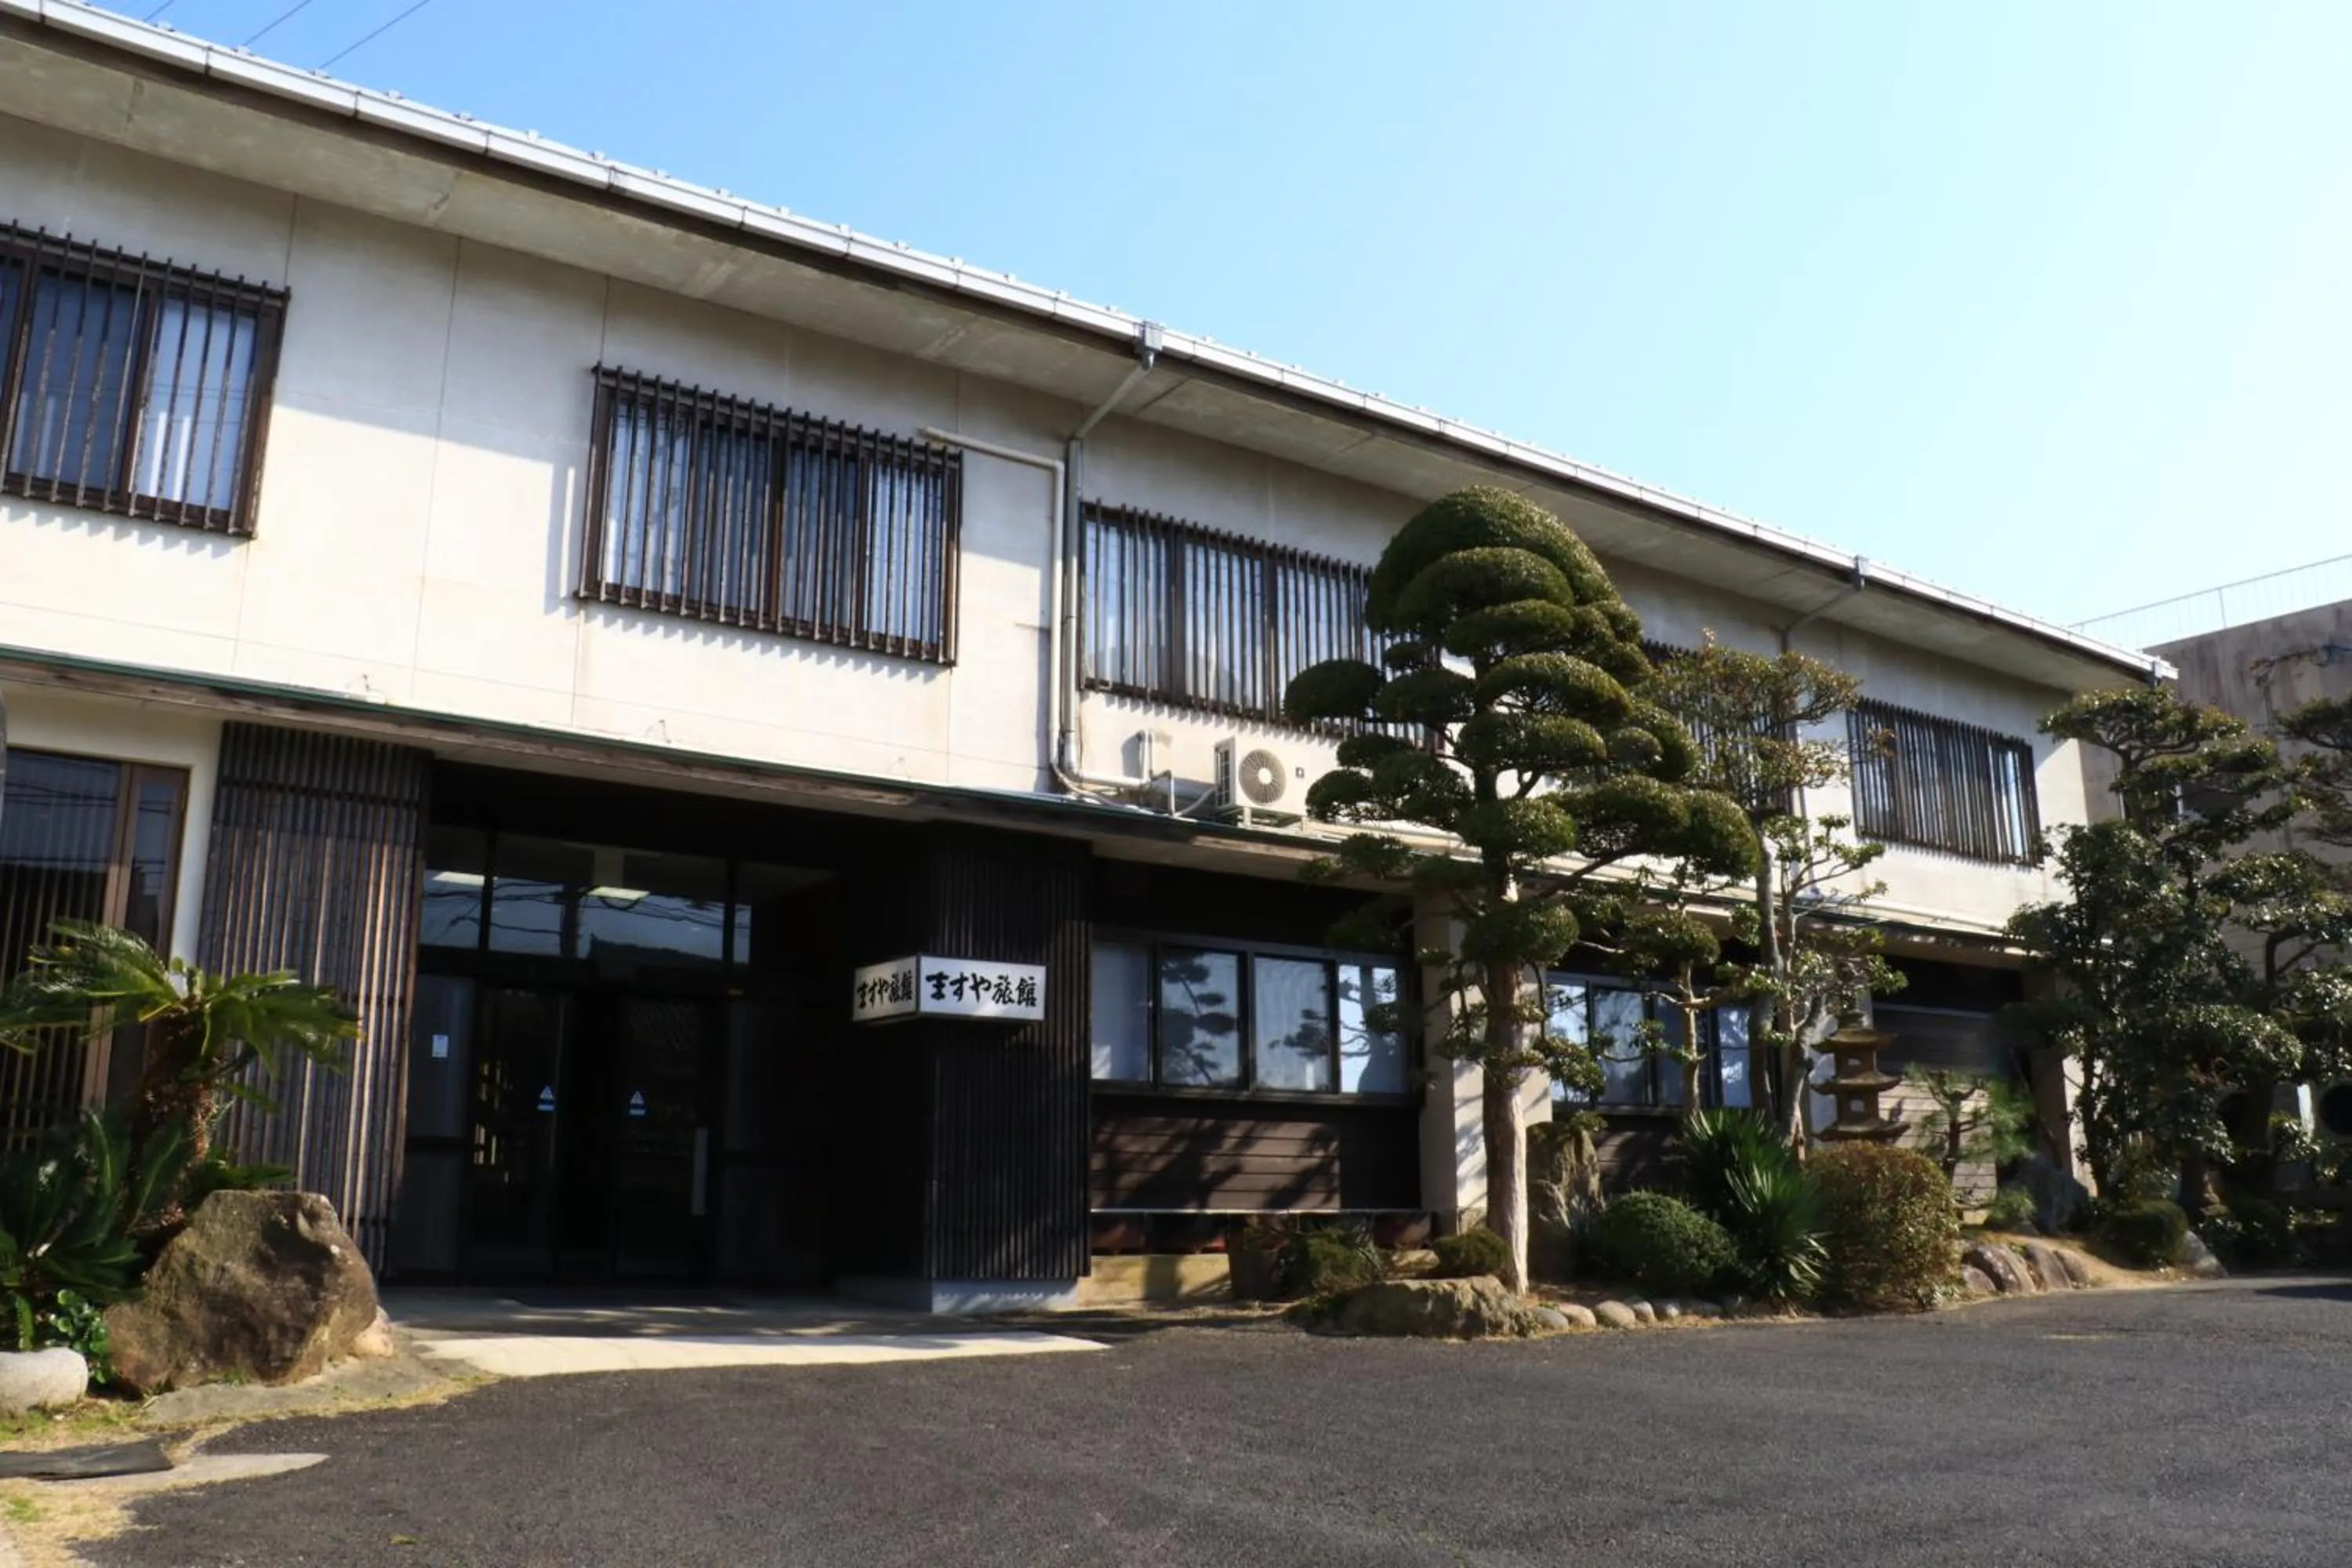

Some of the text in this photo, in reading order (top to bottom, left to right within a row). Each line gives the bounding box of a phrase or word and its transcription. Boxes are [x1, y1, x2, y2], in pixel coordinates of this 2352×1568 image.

[925, 971, 1036, 1007] ますや旅館
